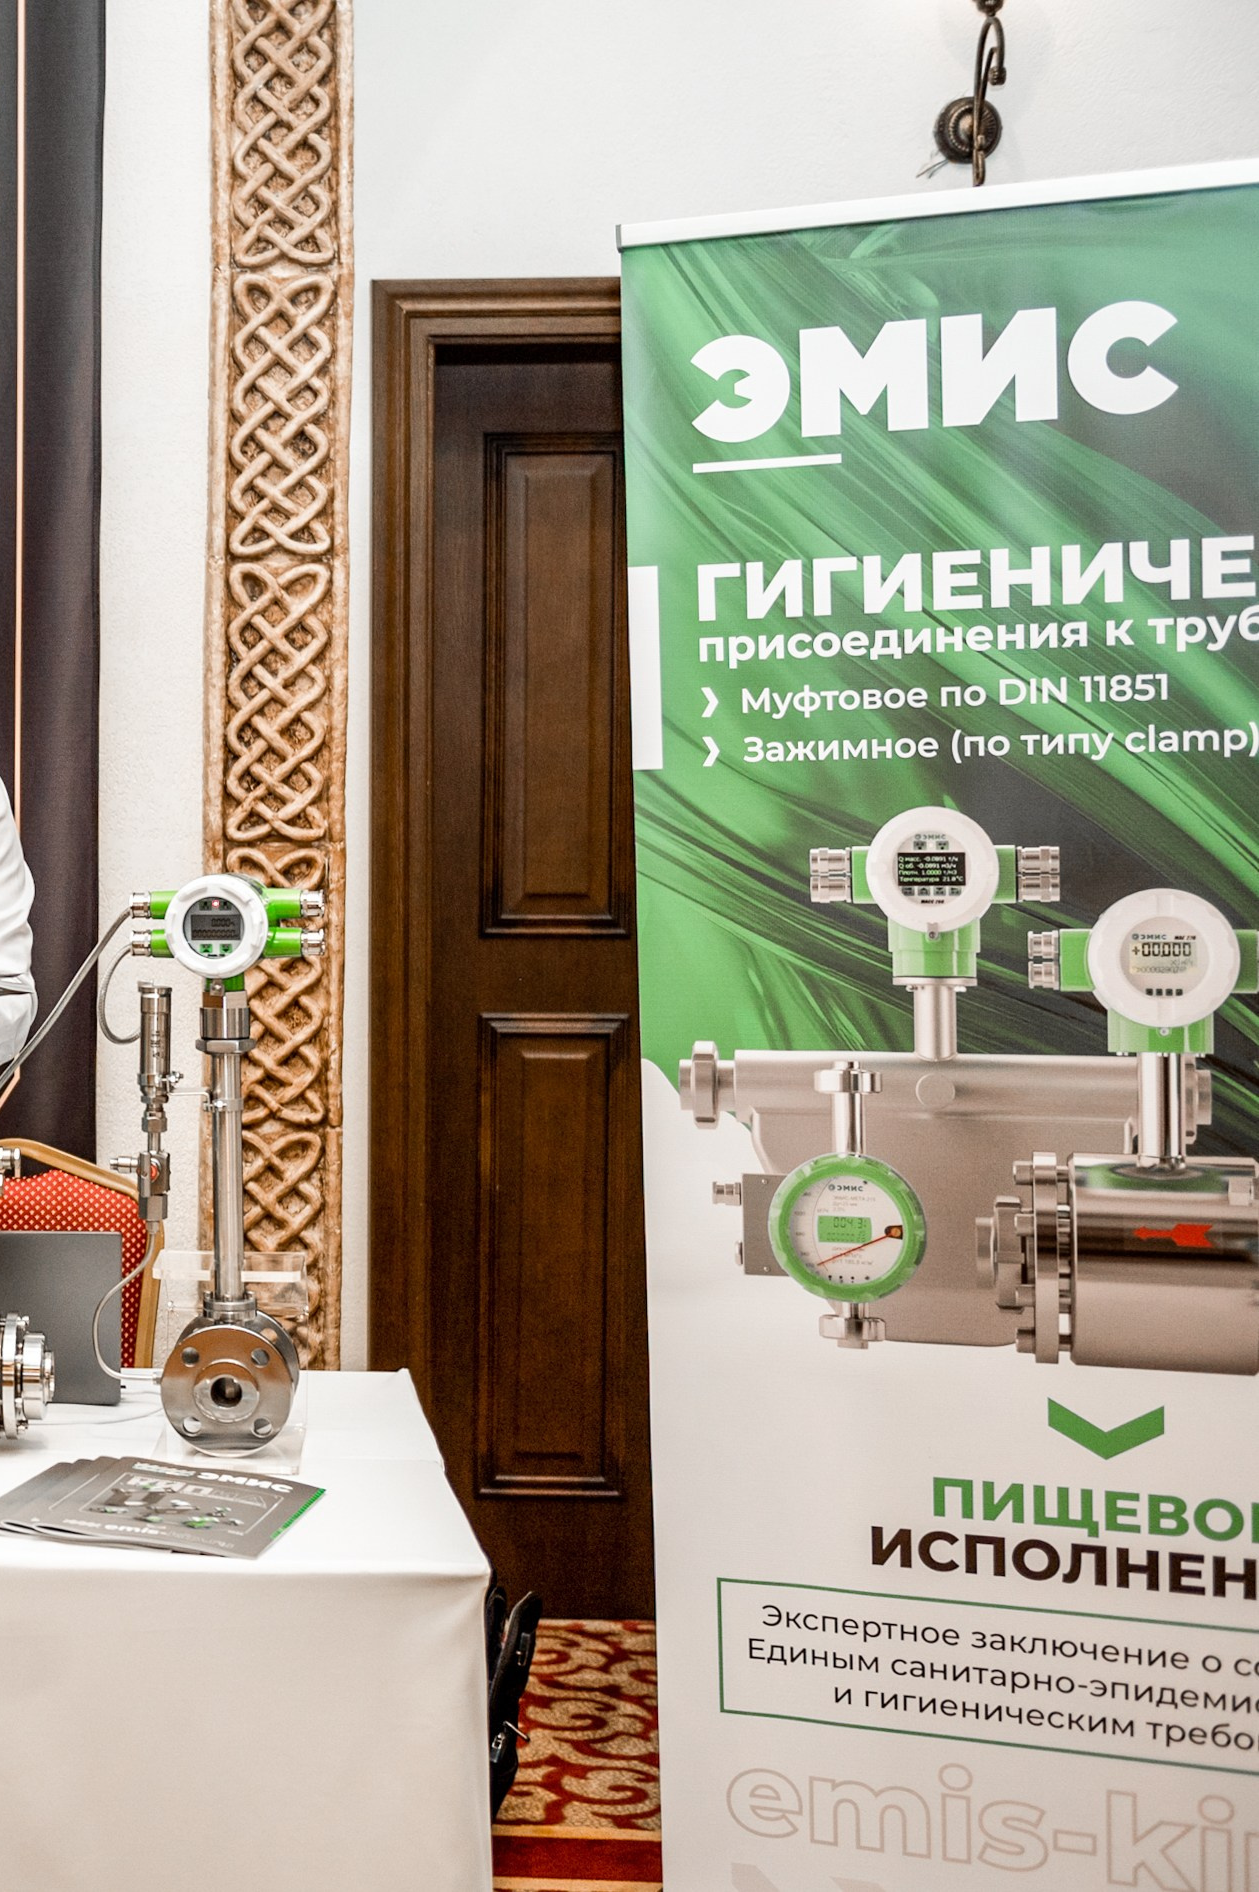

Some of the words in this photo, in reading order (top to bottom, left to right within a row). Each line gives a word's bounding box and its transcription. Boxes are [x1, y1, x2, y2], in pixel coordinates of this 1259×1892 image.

[691, 300, 1180, 443] ЭМИС
[697, 535, 1257, 621] ГИГИЕНИЧЕ
[698, 622, 1088, 668] присоединения
[1107, 620, 1134, 646] к
[741, 684, 928, 720] Муфтовое
[941, 685, 986, 708] по
[1000, 676, 1068, 704] DIN
[1079, 674, 1170, 703] 11851
[744, 736, 939, 764] Зажимное
[951, 731, 1008, 764] (по
[1022, 732, 1114, 765] типу
[1125, 721, 1259, 758] clamp)
[196, 1472, 294, 1493] ЭМИС
[871, 1526, 1257, 1600] ИСПОЛНЕН
[762, 1604, 960, 1647] Экспертное
[970, 1629, 1189, 1671] заключение
[1201, 1653, 1223, 1674] о
[748, 1639, 880, 1676] Единым
[891, 1655, 1259, 1716] санитарно-эпидеми
[834, 1687, 852, 1706] и
[864, 1690, 1136, 1738] гигиеническим
[1146, 1720, 1259, 1755] требо
[726, 1763, 1259, 1892] emis-ki
